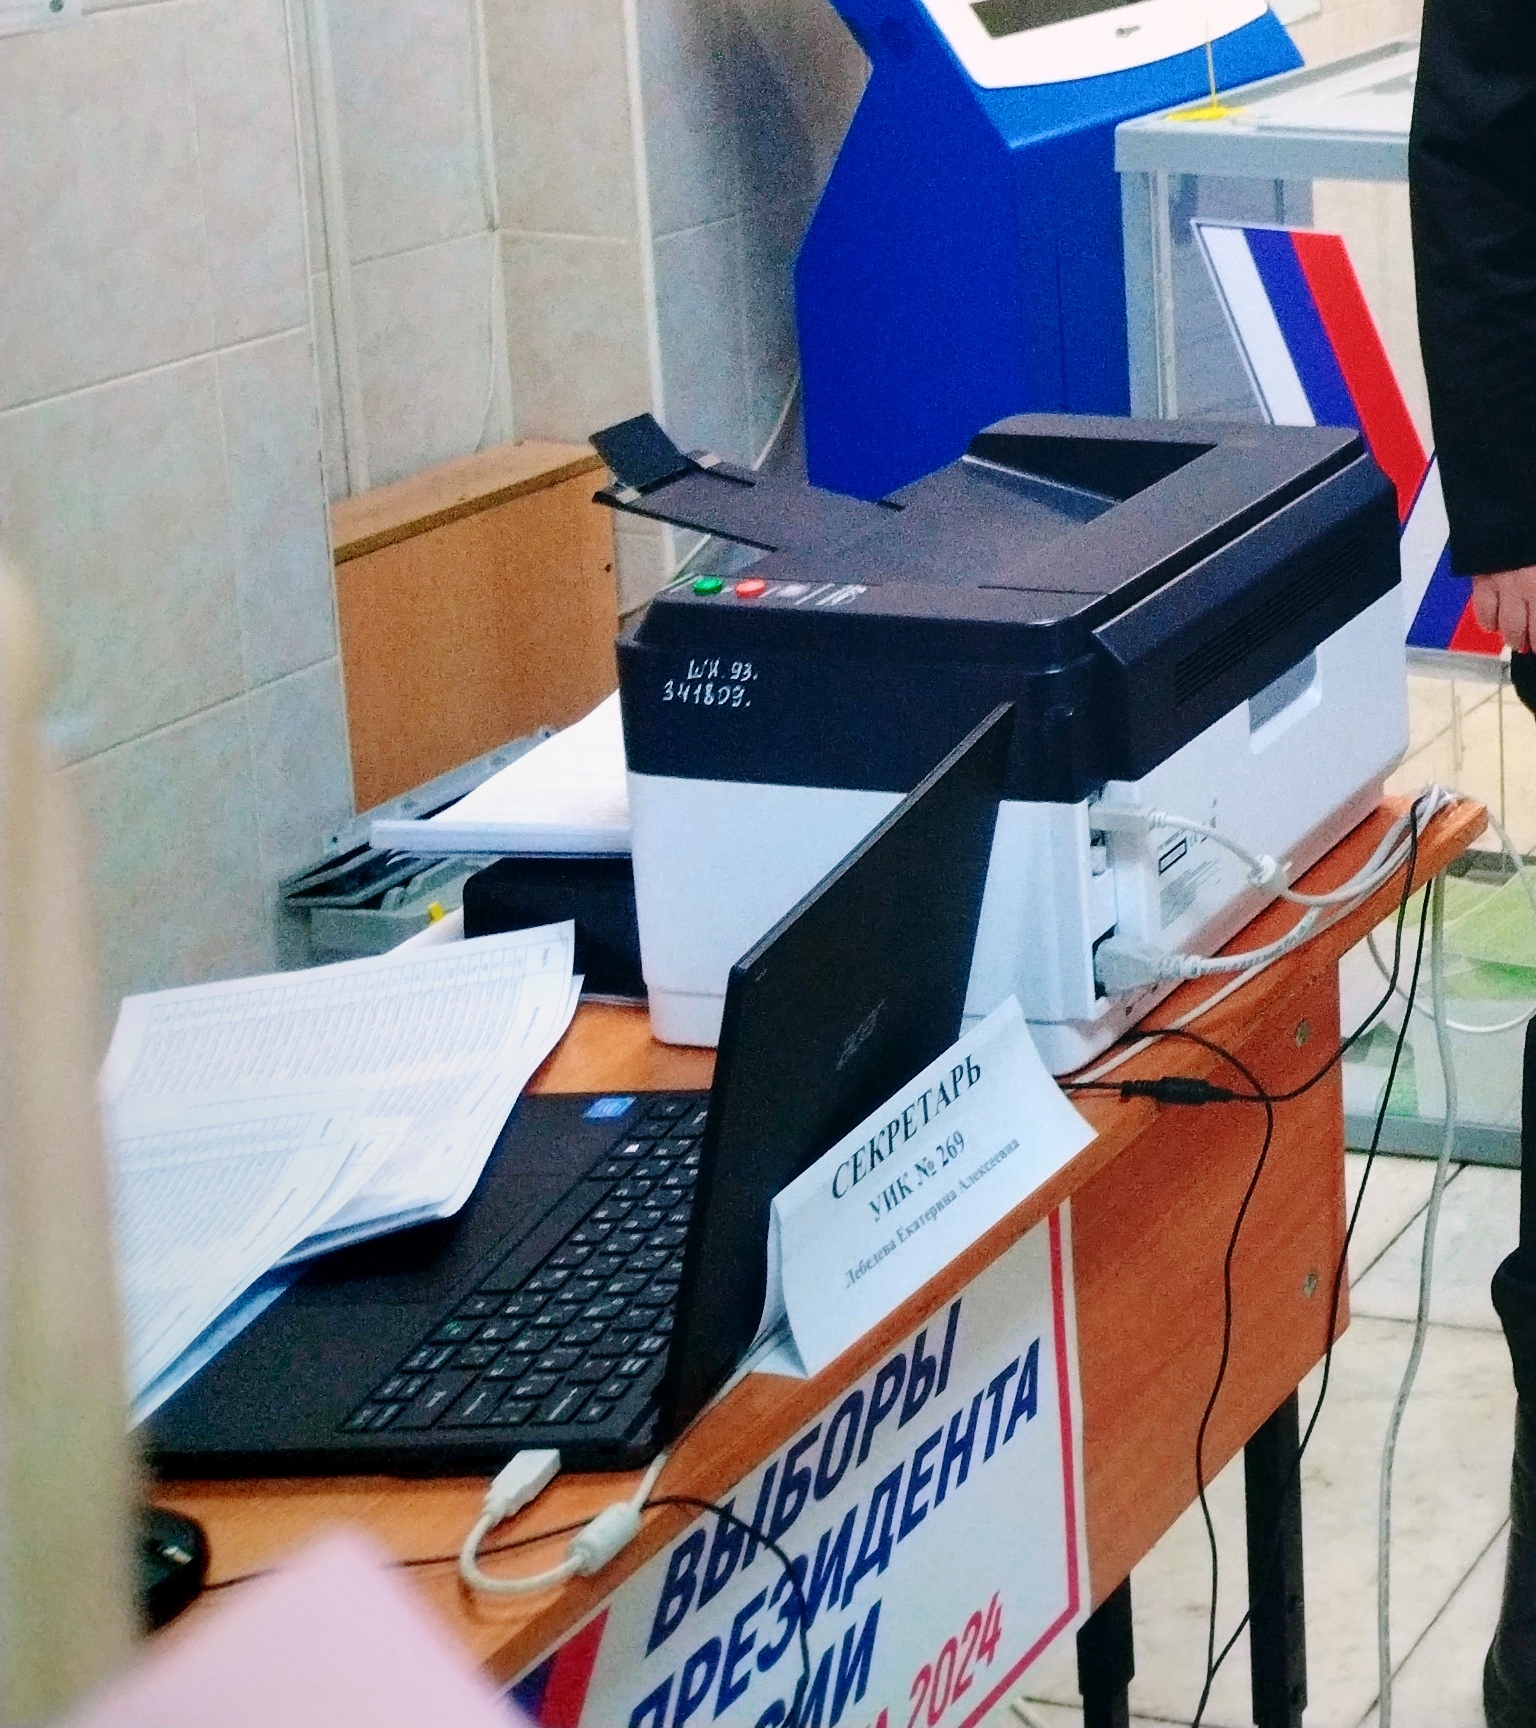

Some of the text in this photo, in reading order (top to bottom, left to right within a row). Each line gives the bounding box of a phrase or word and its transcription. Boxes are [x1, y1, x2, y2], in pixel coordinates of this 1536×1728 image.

[831, 1053, 982, 1201] СЕКРЕТАРЬ
[868, 1171, 914, 1223] УИК
[936, 1130, 966, 1168] 269
[895, 1189, 958, 1244] Екатерина
[959, 1138, 1021, 1194] Алексеевна
[629, 1336, 1040, 1728] ПРЕЗИДЕНТА
[645, 1296, 963, 1659] ВЫБОРЫ
[907, 1588, 1003, 1728] 2024
